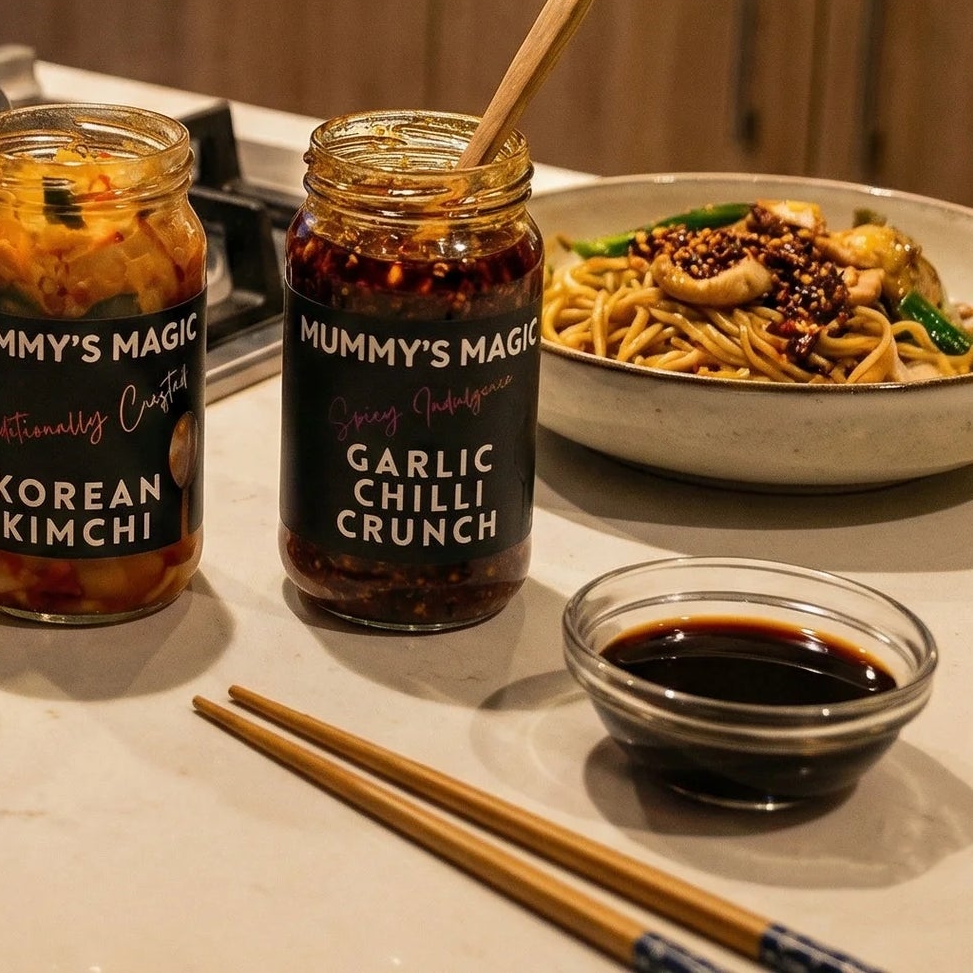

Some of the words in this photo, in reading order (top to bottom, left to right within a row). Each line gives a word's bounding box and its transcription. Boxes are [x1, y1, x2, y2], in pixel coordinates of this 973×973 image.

[112, 312, 197, 361] MAGIC
[301, 314, 450, 368] MUMMY'S
[460, 317, 538, 367] MAGIC
[328, 396, 404, 442] Spicy
[346, 443, 493, 478] GARLIC
[353, 478, 483, 512] CHILLI
[3, 511, 151, 547] KIMCHI
[336, 509, 497, 547] CRUNCH
